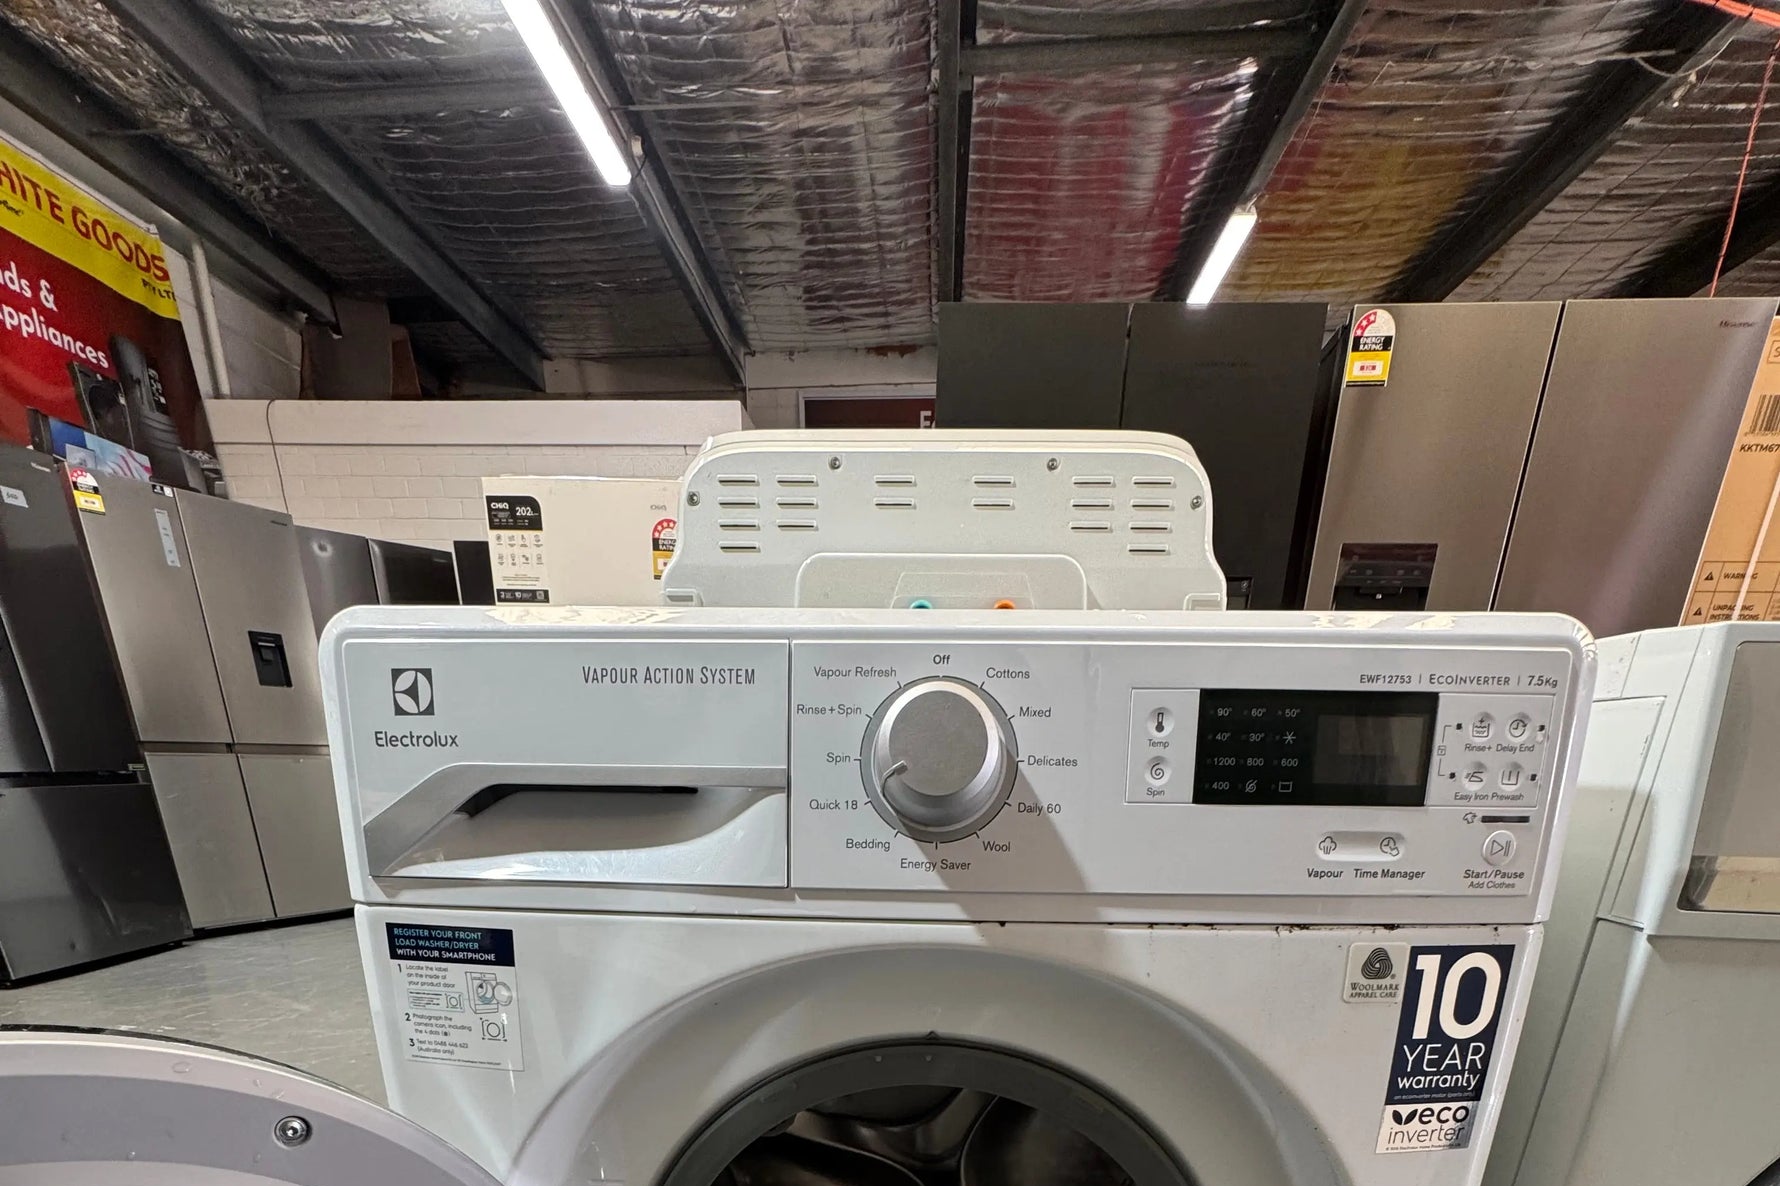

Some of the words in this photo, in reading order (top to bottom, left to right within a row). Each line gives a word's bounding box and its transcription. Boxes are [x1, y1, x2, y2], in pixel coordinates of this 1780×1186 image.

[71, 205, 170, 283] GOODS
[0, 260, 33, 299] ds
[40, 278, 58, 312] &
[0, 303, 109, 368] ppliances
[1360, 336, 1385, 344] ENERGY
[1359, 343, 1384, 351] RATING
[933, 654, 951, 665] Off
[813, 666, 852, 680] Vapour
[855, 666, 897, 678] Refresh
[986, 667, 1031, 680] Cottons
[1359, 674, 1412, 684] EWF12753
[1019, 706, 1052, 718] Mixed
[374, 730, 459, 748] Electrolux
[1147, 739, 1170, 749] Temp
[1496, 743, 1518, 754] Delay
[1519, 744, 1535, 752] End
[826, 752, 851, 765] Spin
[1027, 755, 1078, 767] Delicates
[1213, 757, 1236, 766] 1200
[1211, 781, 1230, 790] 400
[1146, 787, 1165, 798] Spin
[1454, 791, 1473, 802] Easy
[1474, 792, 1489, 800] Iron
[1491, 792, 1525, 800] Prewash
[809, 799, 841, 810] Quick
[844, 799, 858, 810] 18
[1018, 802, 1043, 816] Daily
[1047, 803, 1061, 814] 60
[846, 838, 891, 852] Bedding
[983, 841, 1011, 853] Wool
[900, 858, 937, 871] Energy
[940, 859, 971, 870] Saver
[1306, 868, 1344, 881] Vapour
[1353, 868, 1380, 879] Time
[1380, 869, 1426, 881] Manager
[1463, 869, 1525, 880] Start/Pause
[1467, 880, 1486, 889] Add
[1487, 880, 1516, 889] Clothes
[393, 927, 430, 937] REGISTER
[431, 929, 453, 938] YOUR
[455, 930, 482, 940] FRONT
[395, 938, 417, 947] LOAD
[396, 947, 417, 957] WITH
[417, 949, 440, 958] YOUR
[441, 950, 496, 961] SMARTPHONE
[1350, 982, 1400, 991] WOOLMARK
[1411, 951, 1502, 1040] 10
[404, 1012, 411, 1022] 2
[409, 1037, 416, 1047] 3
[1402, 1042, 1486, 1073] YEAR
[1396, 1070, 1481, 1091] warranty
[1418, 1105, 1470, 1125] eco
[1387, 1124, 1465, 1145] inverter
